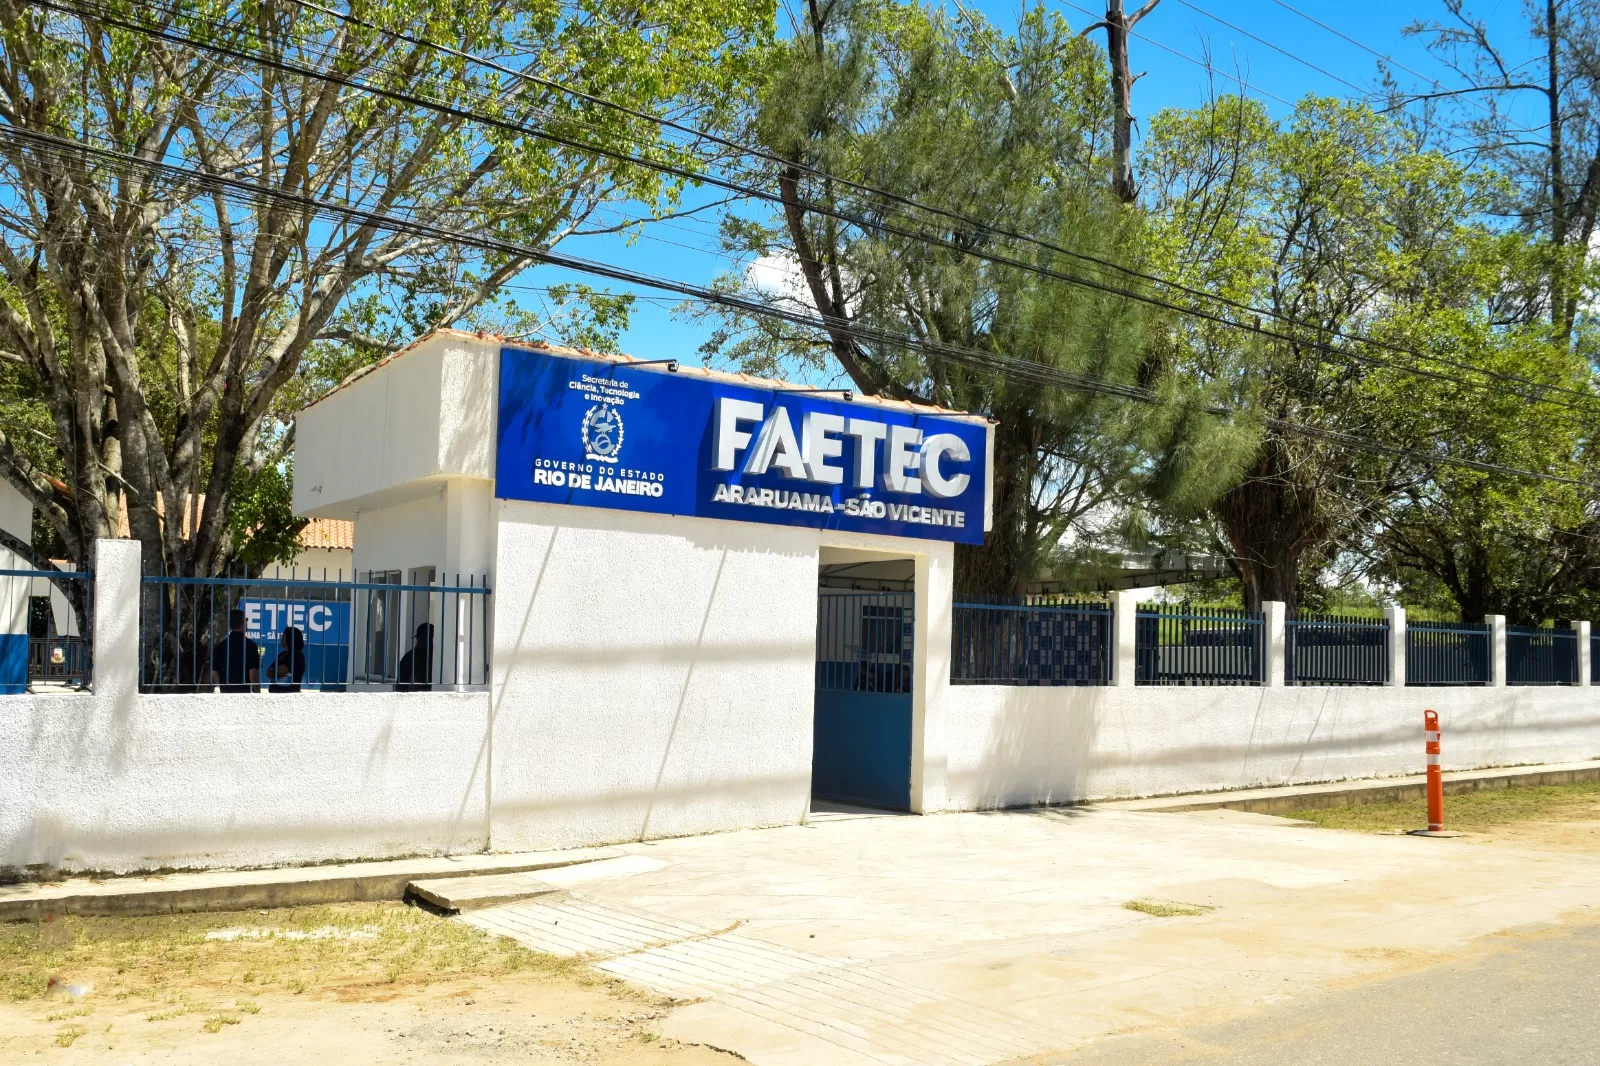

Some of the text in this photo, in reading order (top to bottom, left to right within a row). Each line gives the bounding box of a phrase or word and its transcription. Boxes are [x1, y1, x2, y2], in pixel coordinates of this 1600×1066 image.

[568, 381, 640, 399] Ciência, Tecnologia
[582, 374, 629, 389] Secretaria de
[591, 393, 625, 406] Inovação
[711, 397, 971, 498] FAETEC
[534, 458, 665, 482] GOVERNO DO ESTADO
[534, 468, 664, 498] RIO DE JANEIRO
[712, 483, 834, 514] ARARUAMA
[887, 503, 965, 528] VICENTE
[245, 602, 333, 632] ETEC
